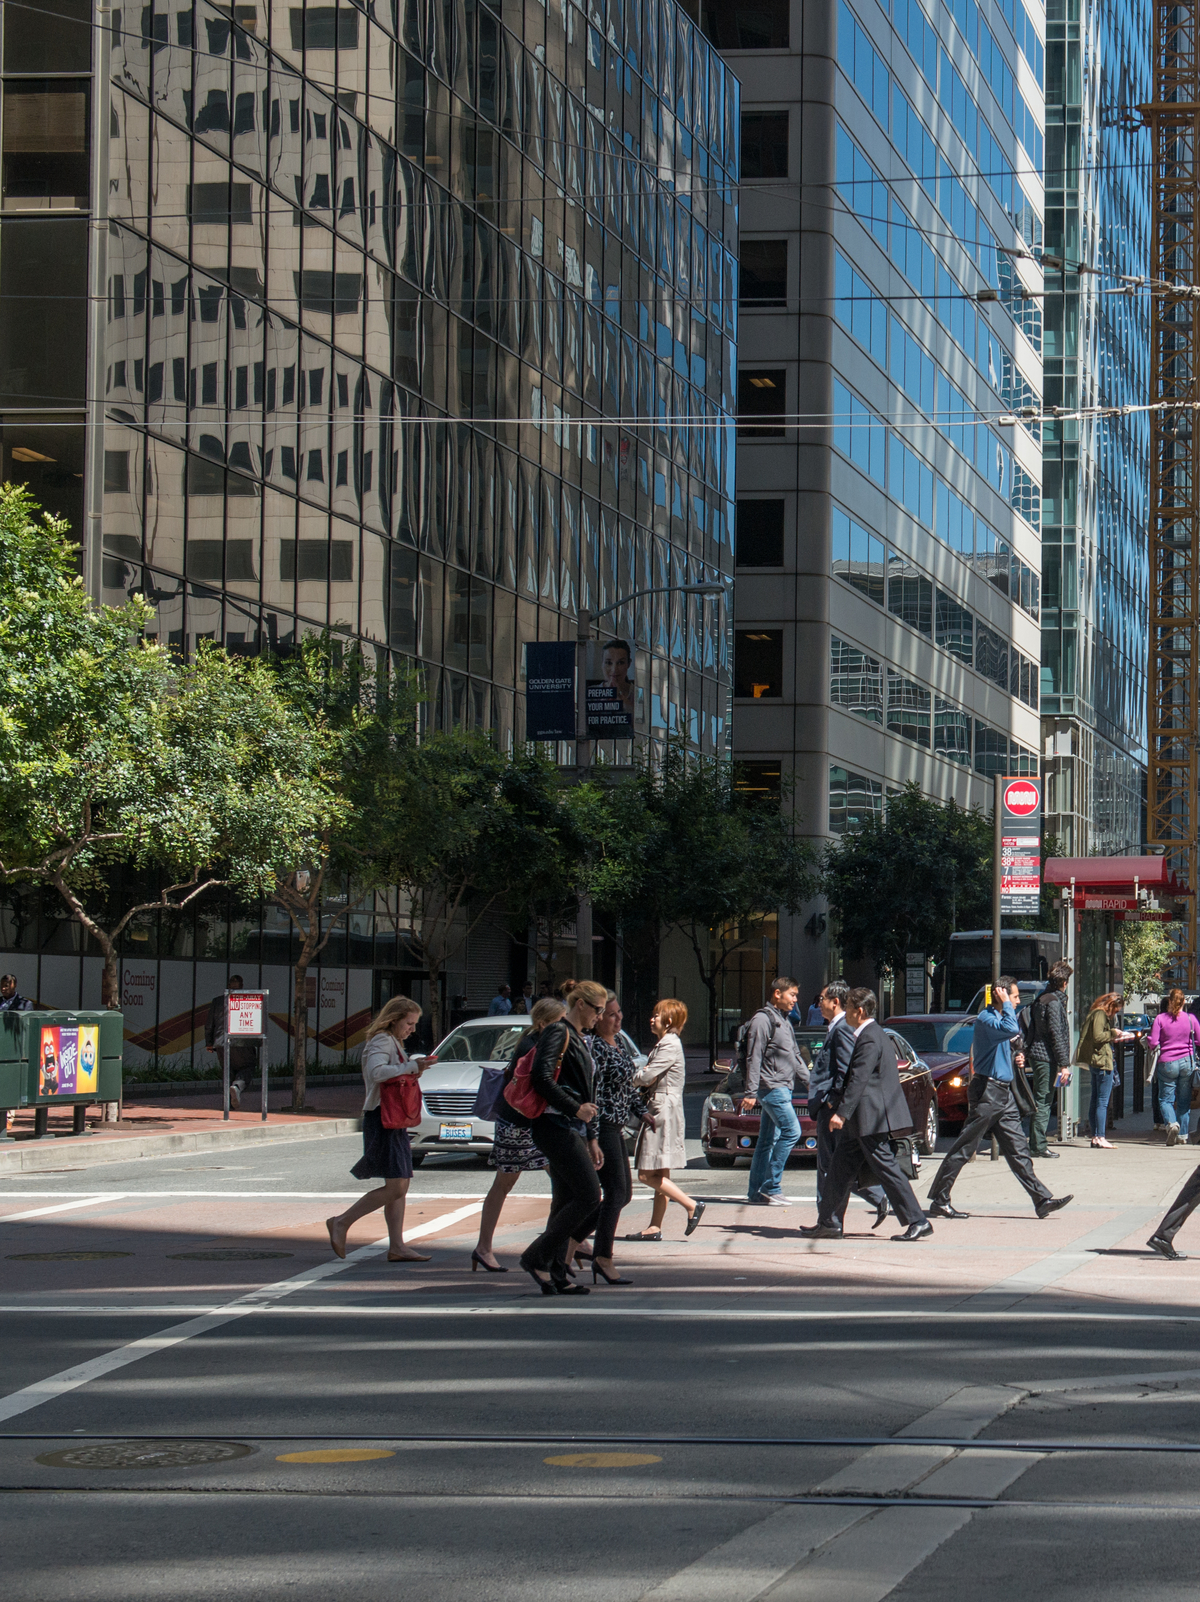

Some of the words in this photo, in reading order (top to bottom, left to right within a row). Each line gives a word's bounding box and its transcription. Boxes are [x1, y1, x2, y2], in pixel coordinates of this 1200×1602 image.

[588, 689, 613, 697] PREPARE
[588, 702, 603, 711] YOUR
[604, 701, 620, 711] MIND
[588, 716, 599, 725] FOR
[600, 715, 629, 725] PRACTICE.
[1002, 847, 1012, 857] 38
[1003, 866, 1010, 876] 7
[1103, 899, 1127, 910] RAPID
[1141, 911, 1163, 921] RAPID
[803, 912, 827, 937] 45
[124, 969, 155, 990] Coming
[322, 977, 344, 995] Coming
[123, 989, 143, 1005] Soon
[320, 993, 336, 1008] Soon
[230, 1000, 240, 1010] NO
[63, 1057, 76, 1079] OUT
[446, 1129, 466, 1137] BUSES
